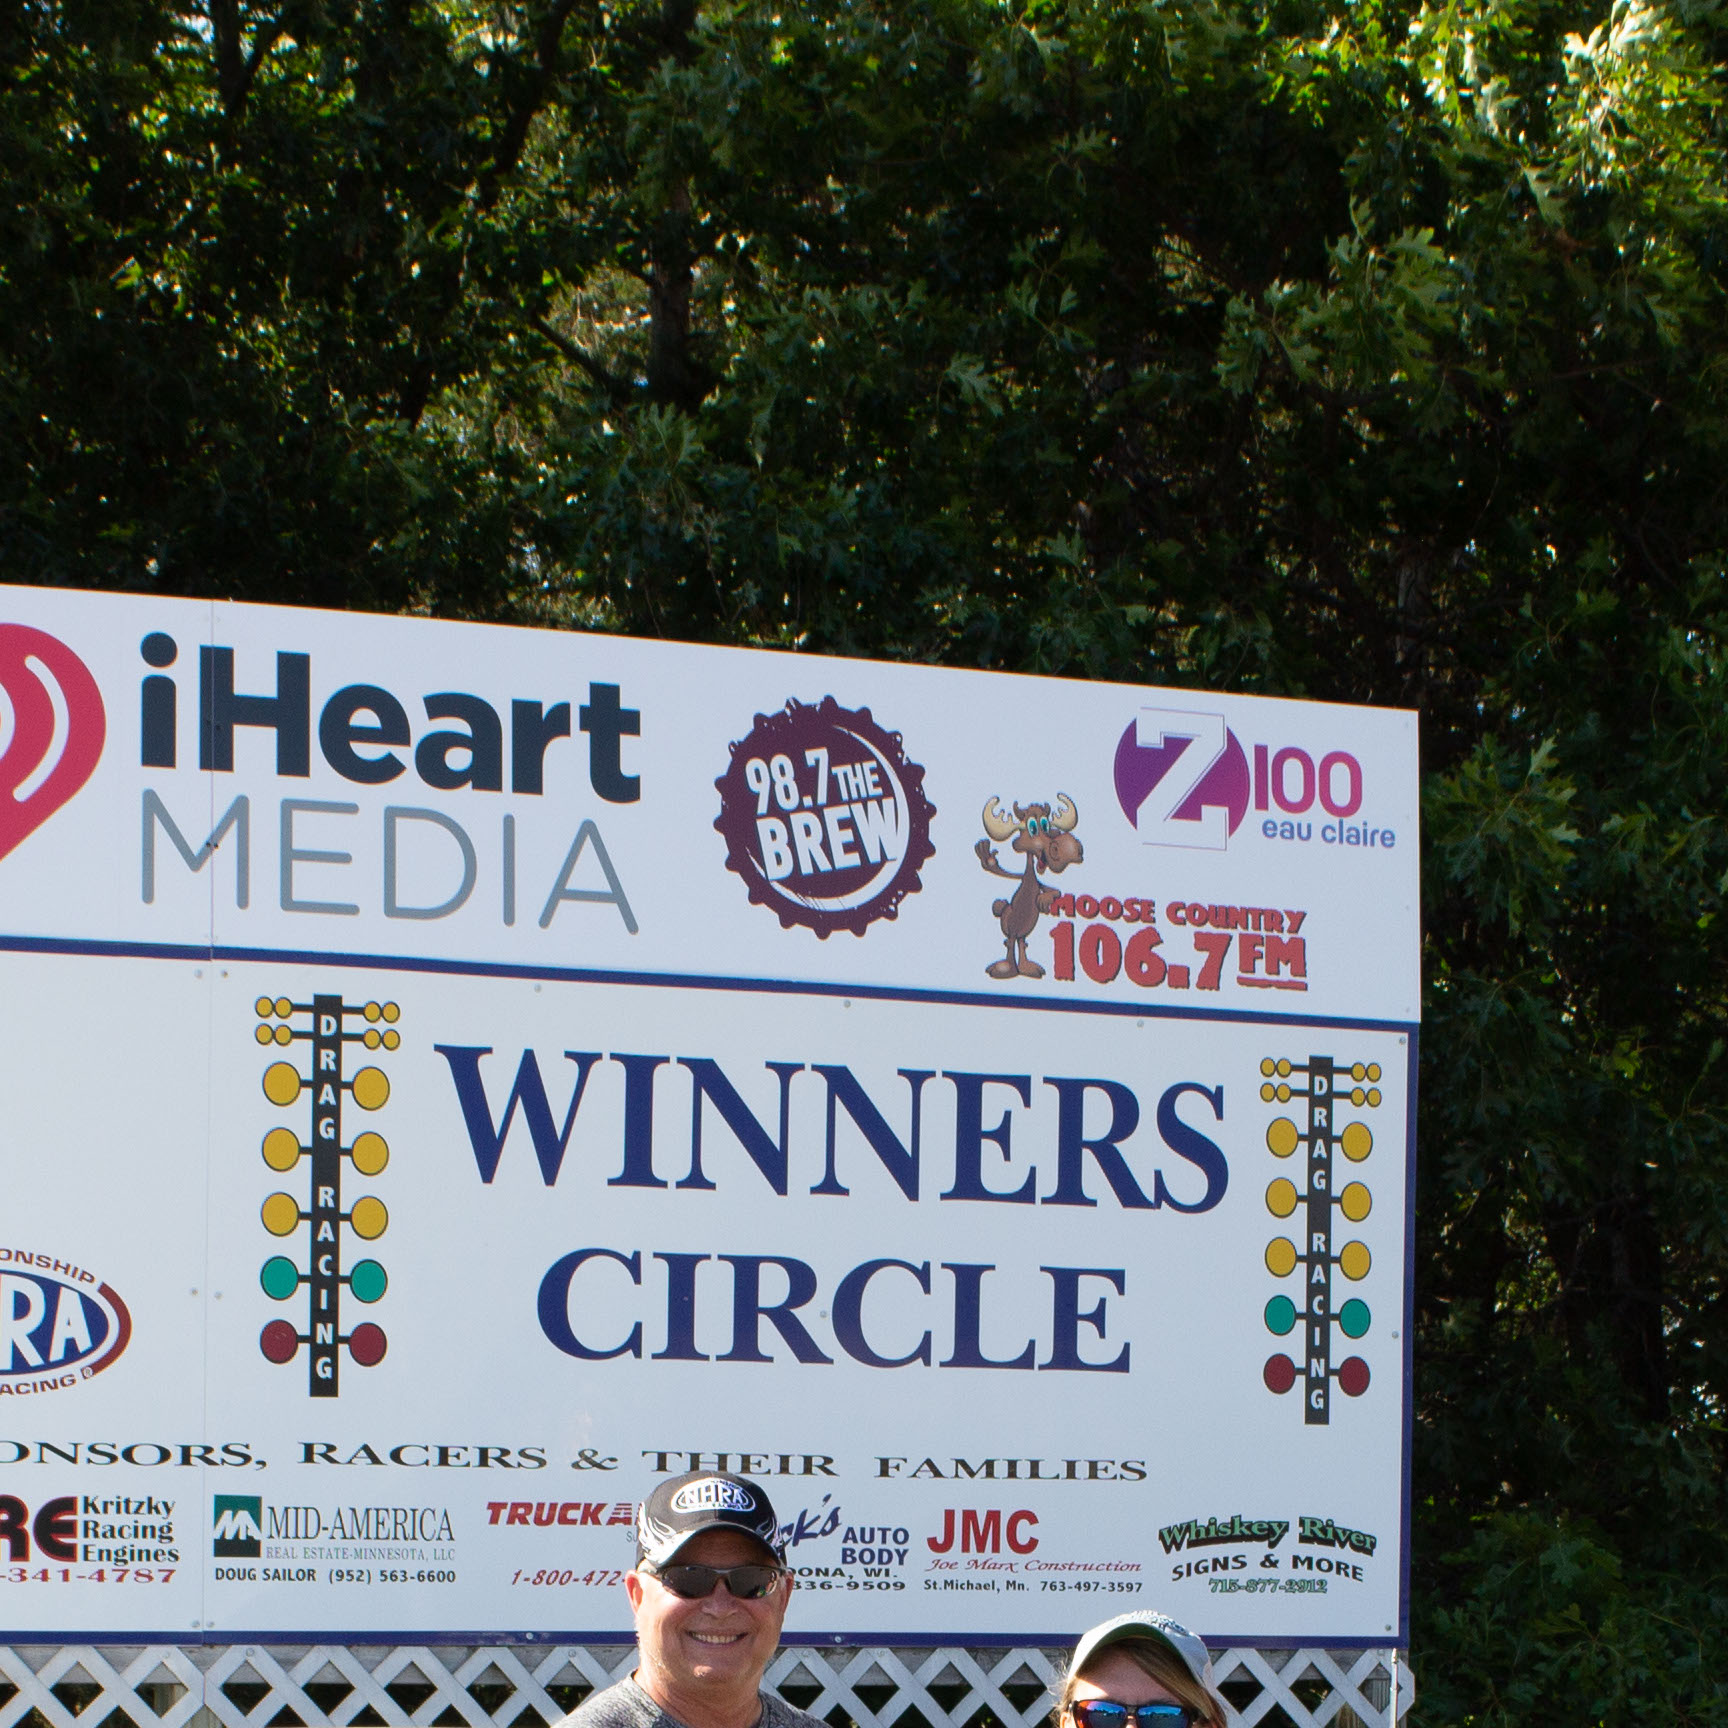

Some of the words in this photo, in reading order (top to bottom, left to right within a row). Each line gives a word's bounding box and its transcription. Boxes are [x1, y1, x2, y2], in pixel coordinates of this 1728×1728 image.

[140, 632, 641, 804] iHeart
[745, 747, 831, 815] 98.7
[831, 760, 884, 802] THE
[755, 797, 902, 882] BREW
[1261, 819, 1314, 843] eau
[1319, 816, 1397, 848] claire
[142, 788, 640, 935] MEDIA
[1050, 892, 1157, 925] MOOSE
[1166, 900, 1309, 935] COUNTRY
[318, 1013, 339, 1141] DRAG
[433, 1043, 1230, 1214] WINNERS
[1312, 1074, 1328, 1192] DRAG
[315, 1185, 336, 1381] RACING
[536, 1247, 1132, 1376] CIRCLE
[1309, 1231, 1327, 1412] RACING
[297, 1441, 548, 1471] RACERS
[572, 1447, 619, 1472] &
[641, 1450, 840, 1477] THEIR
[874, 1455, 1149, 1483] FAMILIES
[83, 1495, 176, 1520] Kritzky
[683, 1484, 745, 1506] NHRA
[83, 1520, 175, 1544] Racing
[267, 1506, 456, 1542] MID-AMERICA
[842, 1527, 910, 1545] AUTO
[927, 1509, 1039, 1554] JMC
[1158, 1514, 1290, 1555] Whiskey
[1298, 1516, 1377, 1557] River
[83, 1544, 181, 1567] Engines
[266, 1546, 299, 1560] REAL
[433, 1548, 456, 1561] LLC
[841, 1547, 910, 1566] BODY
[864, 1567, 898, 1578] WI.
[924, 1559, 958, 1572] Joe
[965, 1558, 1020, 1573] Marx
[1024, 1560, 1142, 1572] Construction
[1172, 1555, 1248, 1582] SIGNS
[1259, 1554, 1279, 1569] &
[1292, 1555, 1365, 1582] MORE
[215, 1567, 257, 1581] DOUG
[262, 1568, 317, 1582] SAILOR
[328, 1569, 372, 1585] (952)
[379, 1570, 457, 1583] 563-6600
[1006, 1580, 1030, 1592] Mn.
[1040, 1581, 1143, 1593] 763-497-3597
